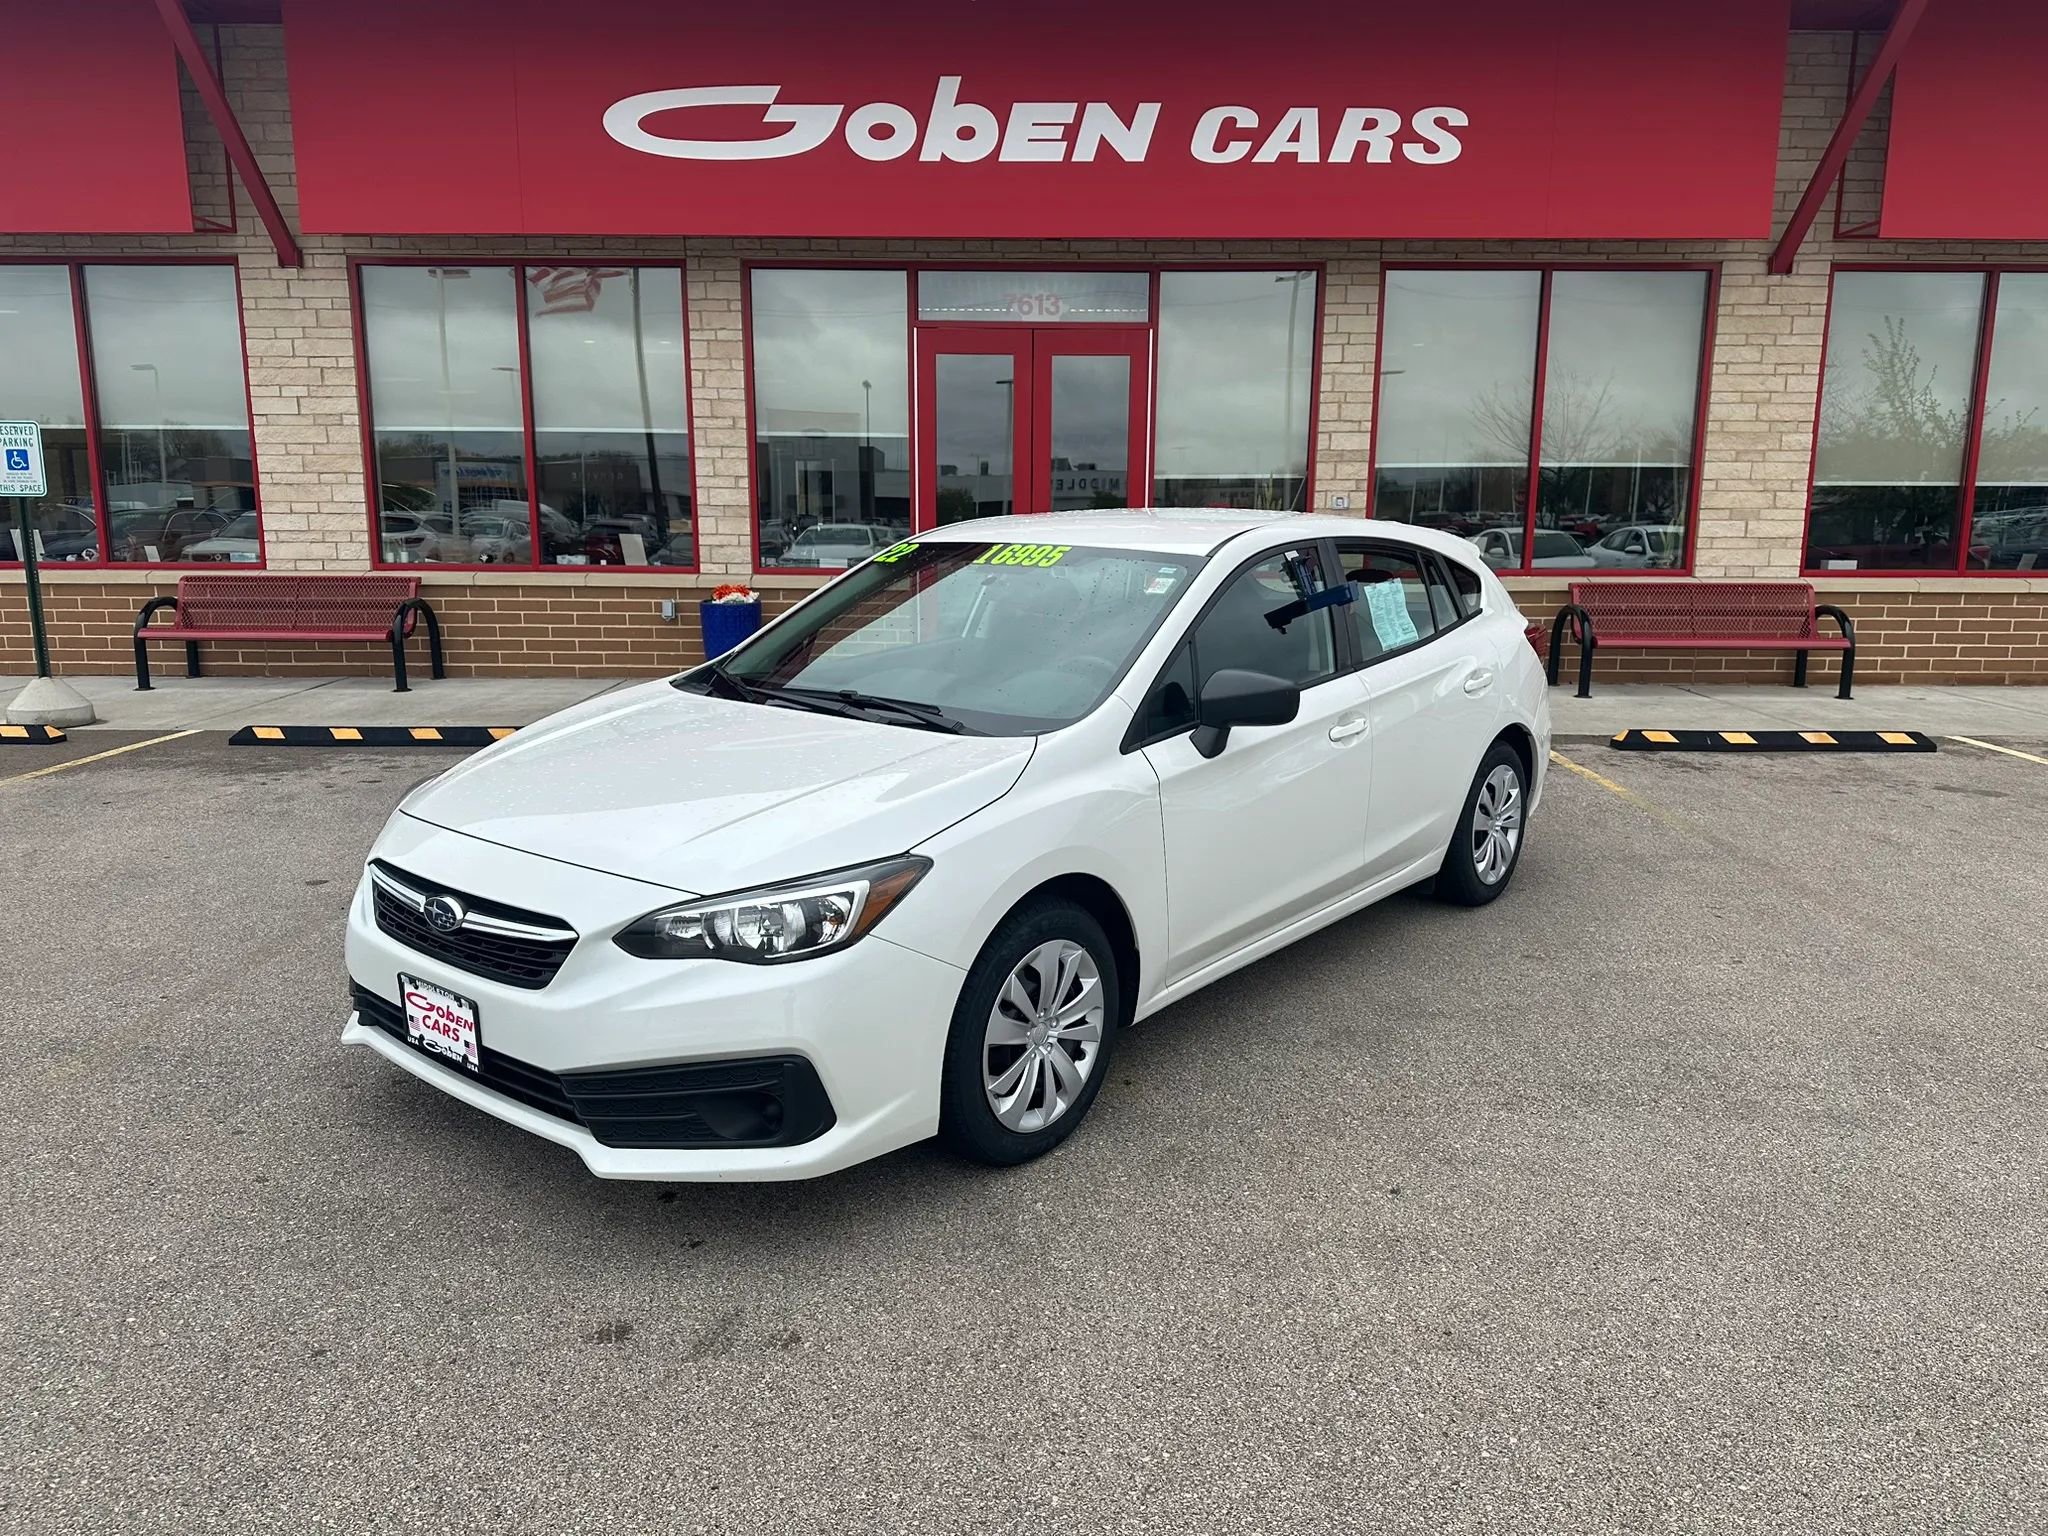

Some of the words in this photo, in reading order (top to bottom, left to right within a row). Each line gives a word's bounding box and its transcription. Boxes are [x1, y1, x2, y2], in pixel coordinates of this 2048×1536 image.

[1190, 105, 1469, 165] CARS
[1004, 293, 1061, 316] 7613
[20, 484, 42, 492] SPACE
[972, 543, 1072, 567] 16995
[422, 1014, 460, 1042] CARS
